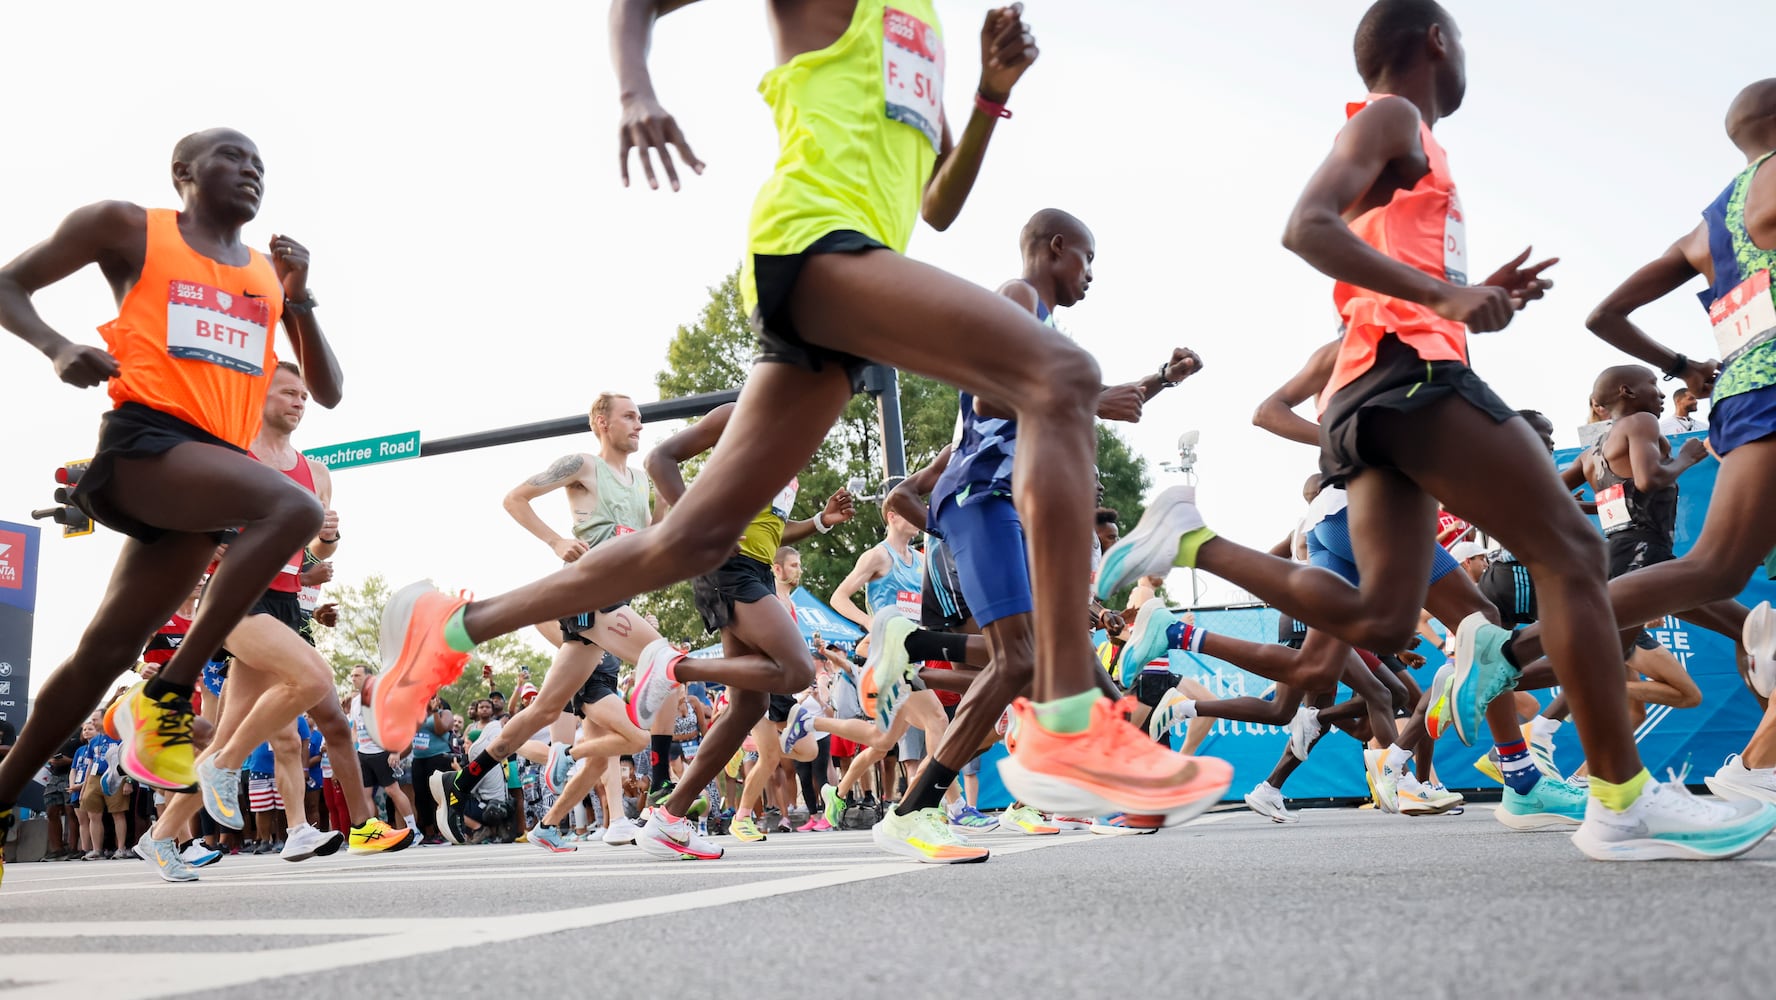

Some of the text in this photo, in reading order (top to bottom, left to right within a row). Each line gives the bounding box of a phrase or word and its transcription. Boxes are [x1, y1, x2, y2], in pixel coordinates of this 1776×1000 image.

[887, 60, 905, 89] F.
[1447, 233, 1461, 256] D.
[177, 283, 196, 292] JULY
[177, 289, 204, 301] 2022
[196, 319, 249, 349] BETT
[1734, 313, 1752, 337] 11
[379, 437, 415, 457] Road
